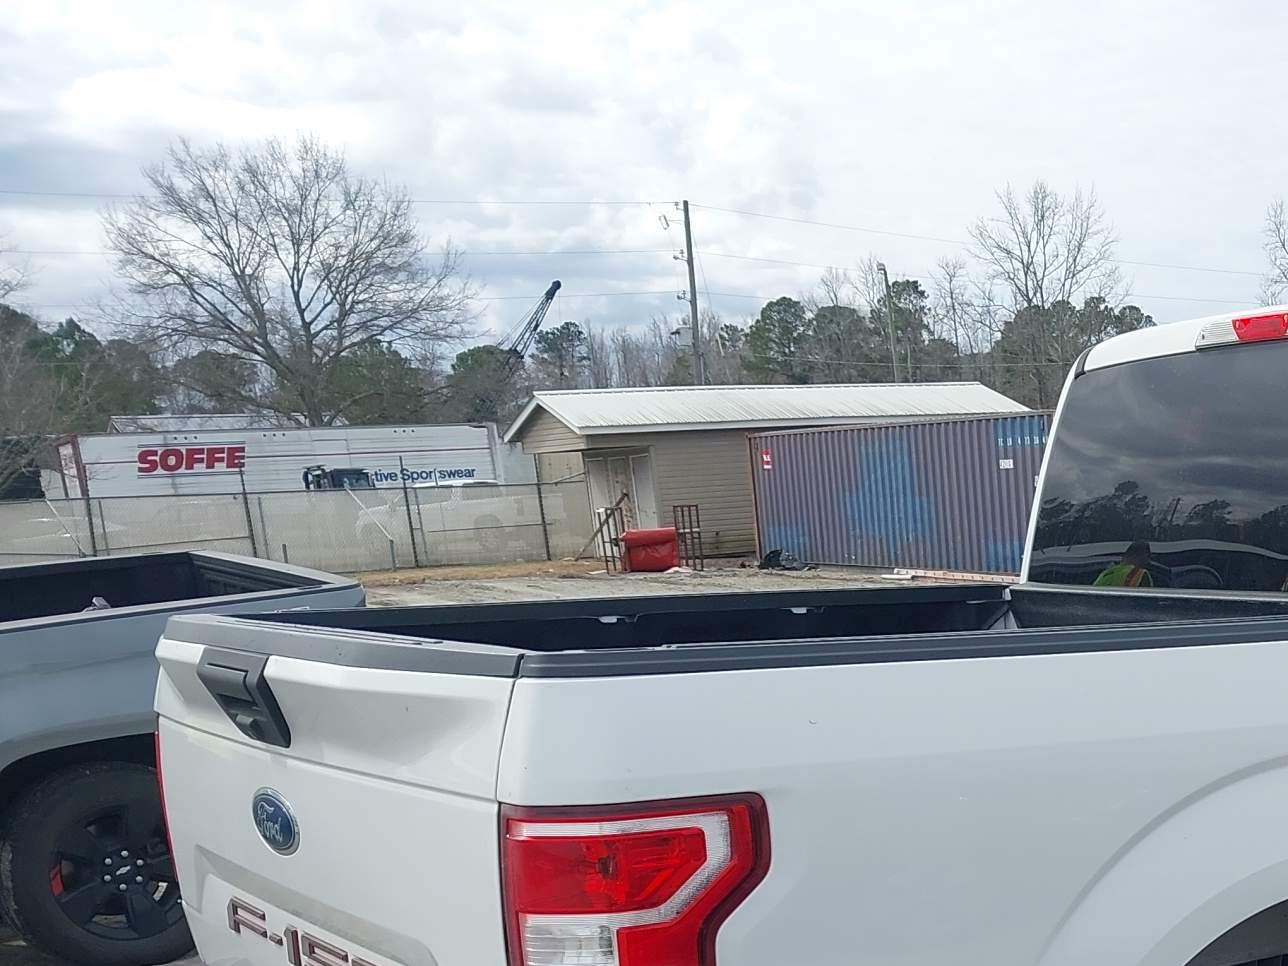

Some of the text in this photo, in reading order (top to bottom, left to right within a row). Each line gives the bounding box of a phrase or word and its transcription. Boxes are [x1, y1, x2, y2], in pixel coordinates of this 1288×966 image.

[137, 446, 246, 473] SOFFE
[371, 468, 398, 482] tive
[256, 801, 284, 843] Ford
